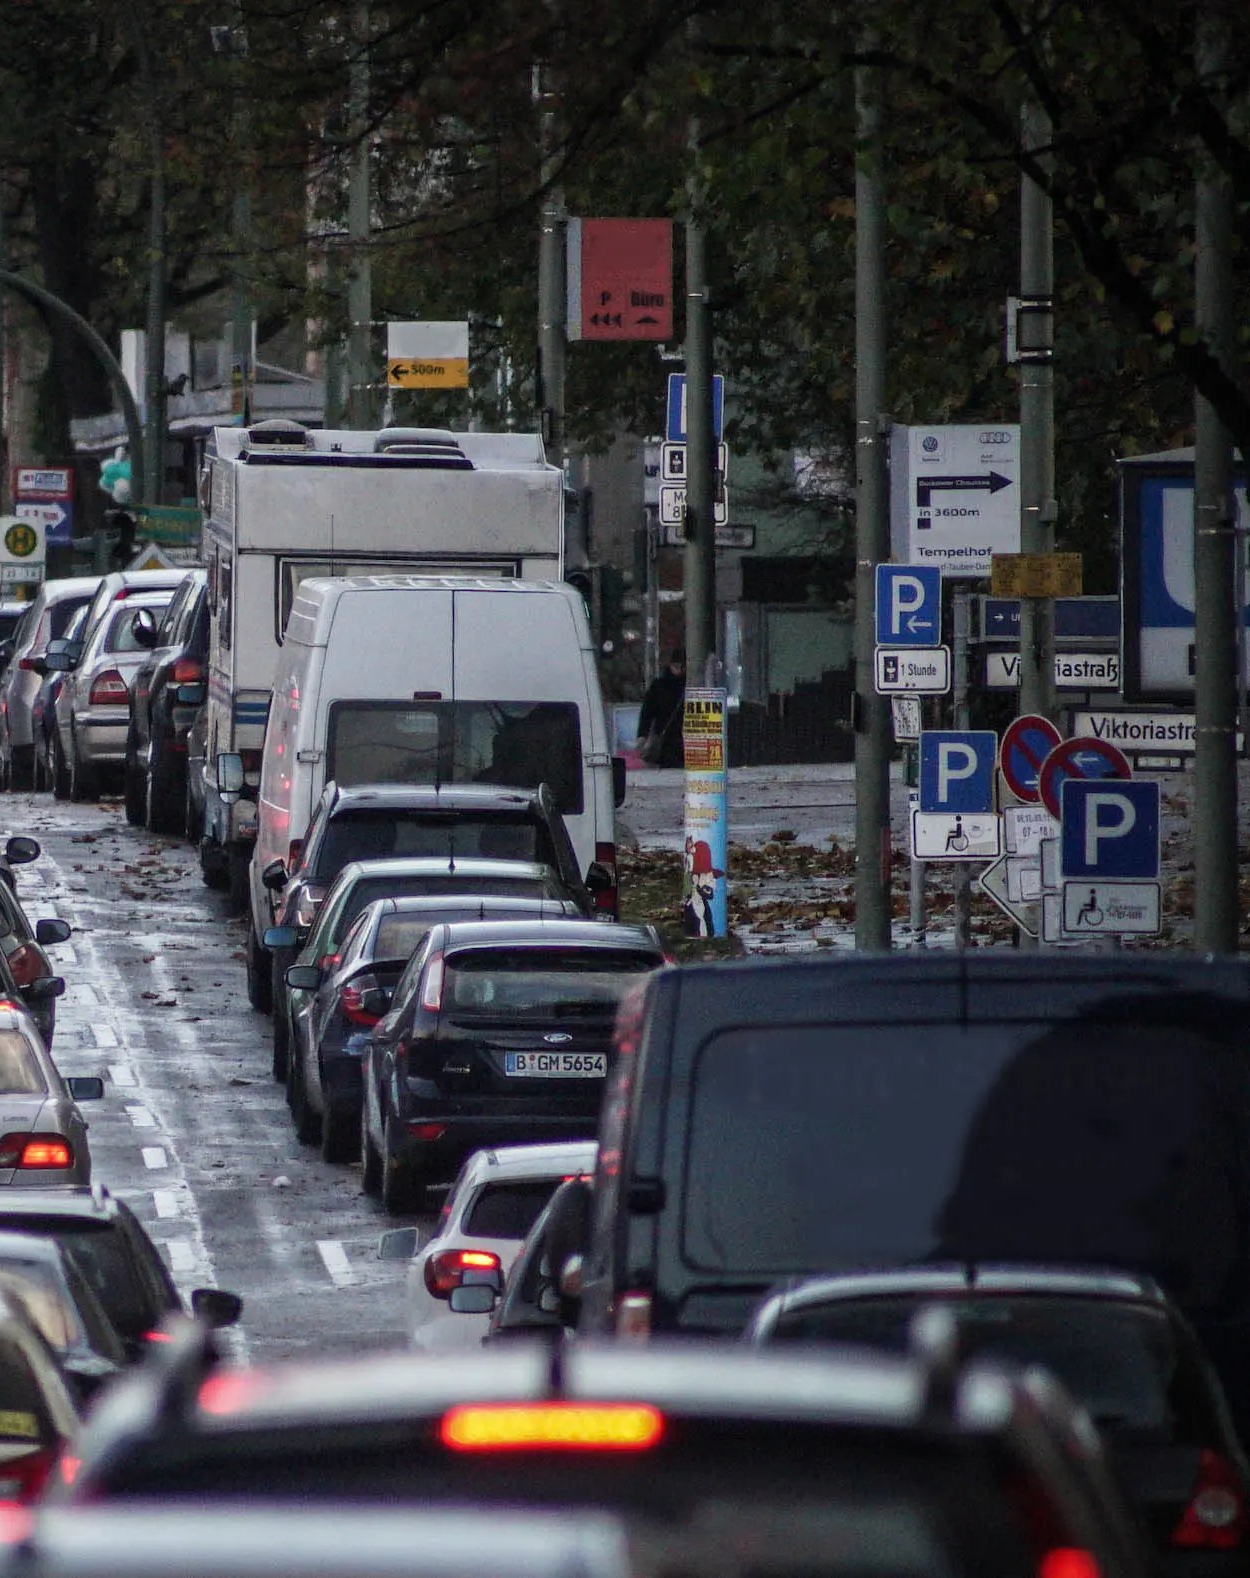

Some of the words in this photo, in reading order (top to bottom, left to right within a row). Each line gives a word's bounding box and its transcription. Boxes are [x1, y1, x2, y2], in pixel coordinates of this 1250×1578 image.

[601, 291, 611, 306] P
[919, 508, 931, 517] in
[934, 508, 980, 517] 3600m
[918, 547, 993, 558] Tempelhof
[891, 575, 925, 635] P
[908, 664, 937, 676] Stunde
[1090, 716, 1198, 741] Viktoriastra
[938, 742, 978, 803] P
[1085, 792, 1136, 866] P
[516, 1055, 526, 1070] B
[537, 1055, 559, 1071] GM
[562, 1055, 603, 1071] 5654
